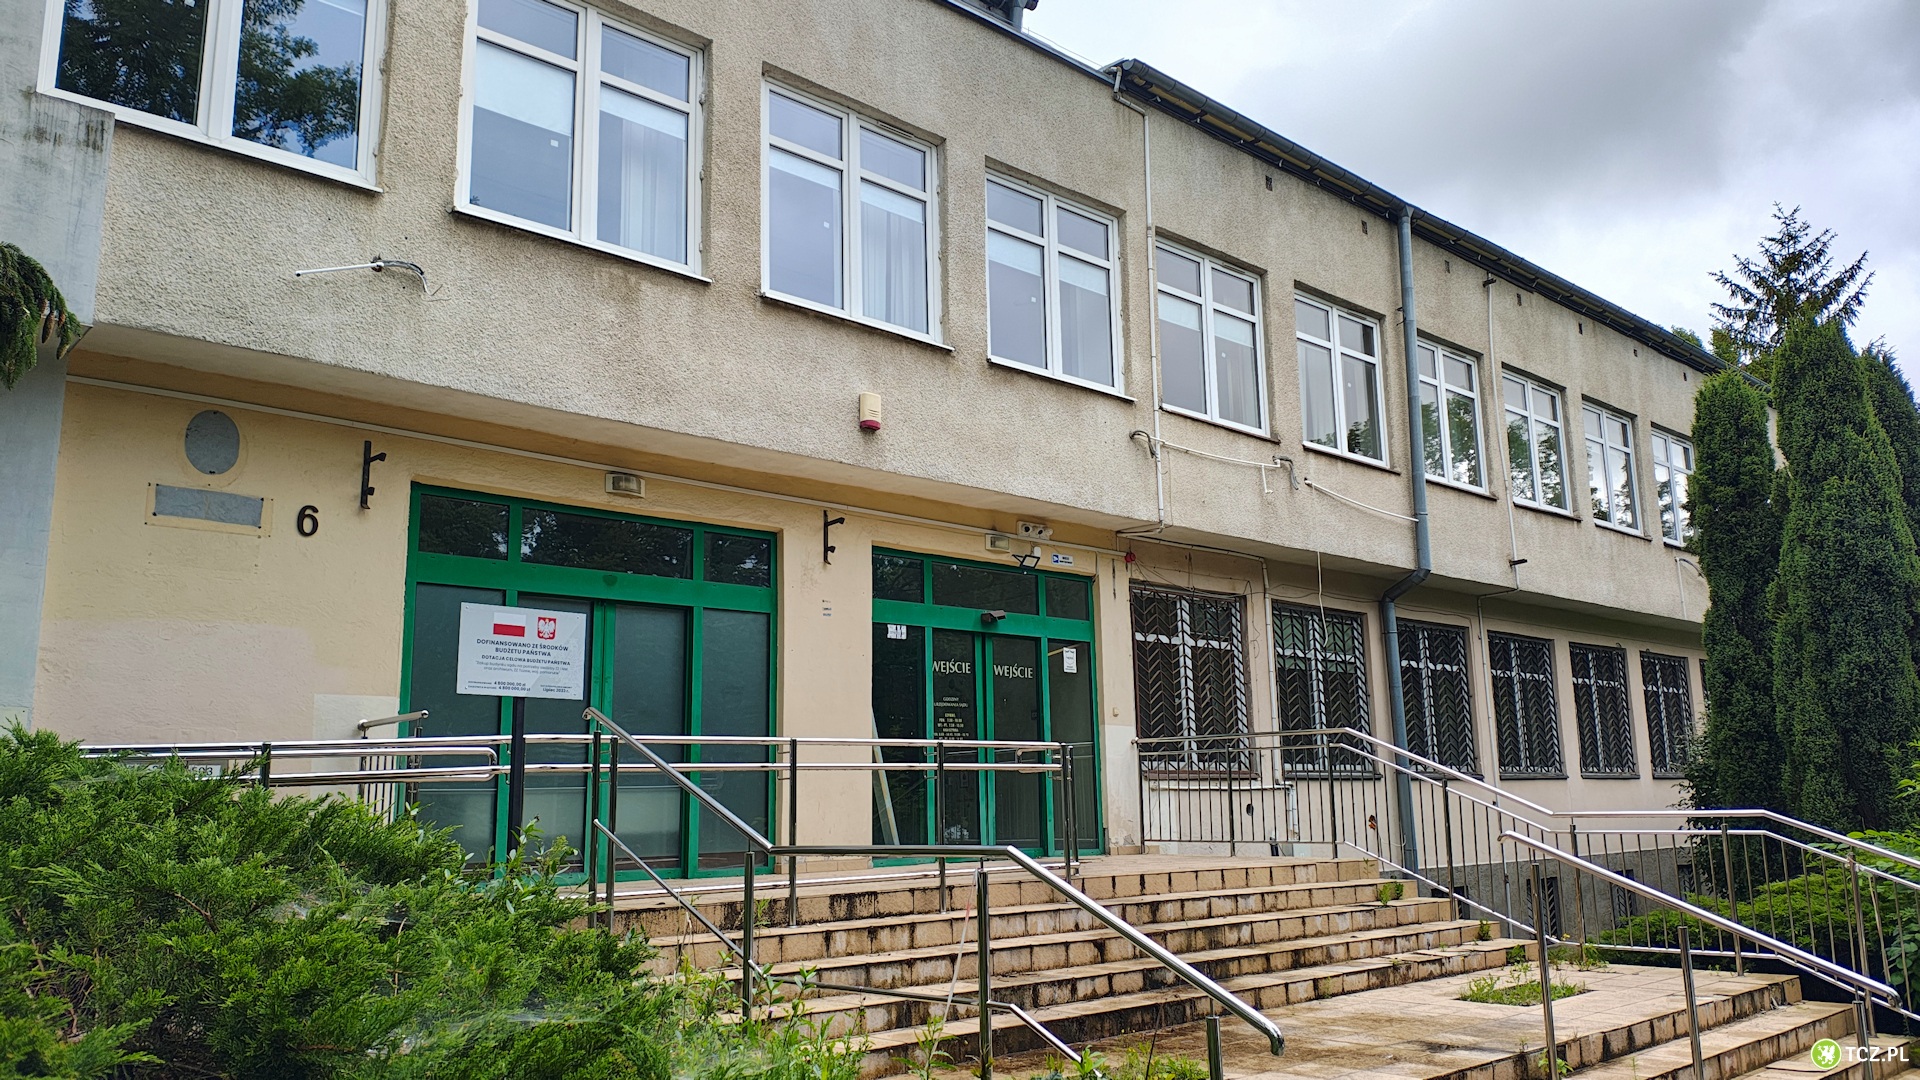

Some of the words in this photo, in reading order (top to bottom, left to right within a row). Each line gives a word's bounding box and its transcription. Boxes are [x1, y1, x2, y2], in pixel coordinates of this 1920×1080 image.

[297, 504, 319, 537] 6
[476, 638, 531, 648] DOFINANSOWANO
[539, 642, 568, 652] ŚRODKÓW
[495, 646, 522, 654] BUDŻETU
[522, 648, 551, 657] PAŃSTWA
[932, 658, 971, 674] WEJŚCIE
[994, 663, 1034, 679] WEJŚCIE
